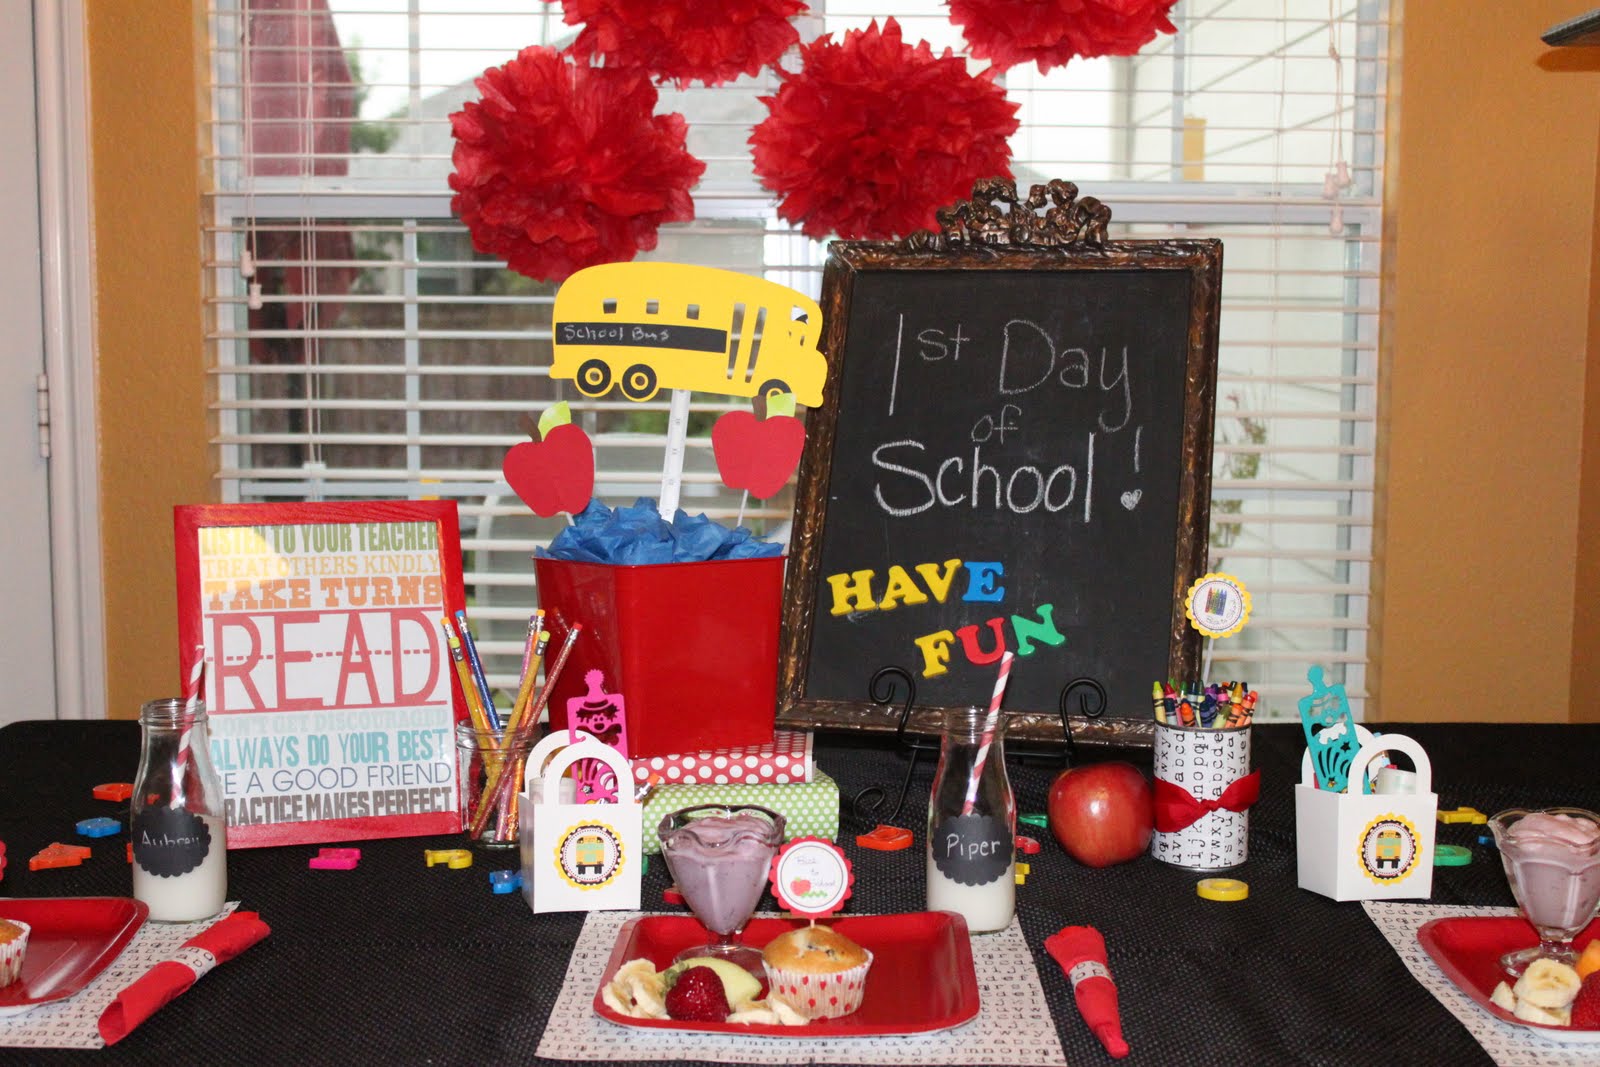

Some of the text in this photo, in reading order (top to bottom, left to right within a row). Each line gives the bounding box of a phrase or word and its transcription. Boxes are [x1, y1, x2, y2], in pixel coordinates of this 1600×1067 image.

[564, 324, 624, 342] School
[888, 313, 1132, 433] 1st Day
[970, 403, 1022, 445] of
[271, 524, 297, 554] TO
[299, 522, 353, 553] YOUR
[355, 521, 438, 552] TEACHER
[203, 553, 440, 579] TREAT OTHERS KINDLY
[204, 575, 442, 611] TAKE TURNS
[826, 558, 1006, 617] HAVE
[914, 603, 1066, 679] FUN
[207, 608, 445, 714] READ
[271, 713, 309, 735] GET
[211, 728, 448, 771] ALWAYS DO YOUR BEST
[224, 762, 452, 795] E A GOOD FRIEND
[224, 786, 452, 828] RACTICE MAKES PERFECT
[946, 833, 1001, 860] Piper
